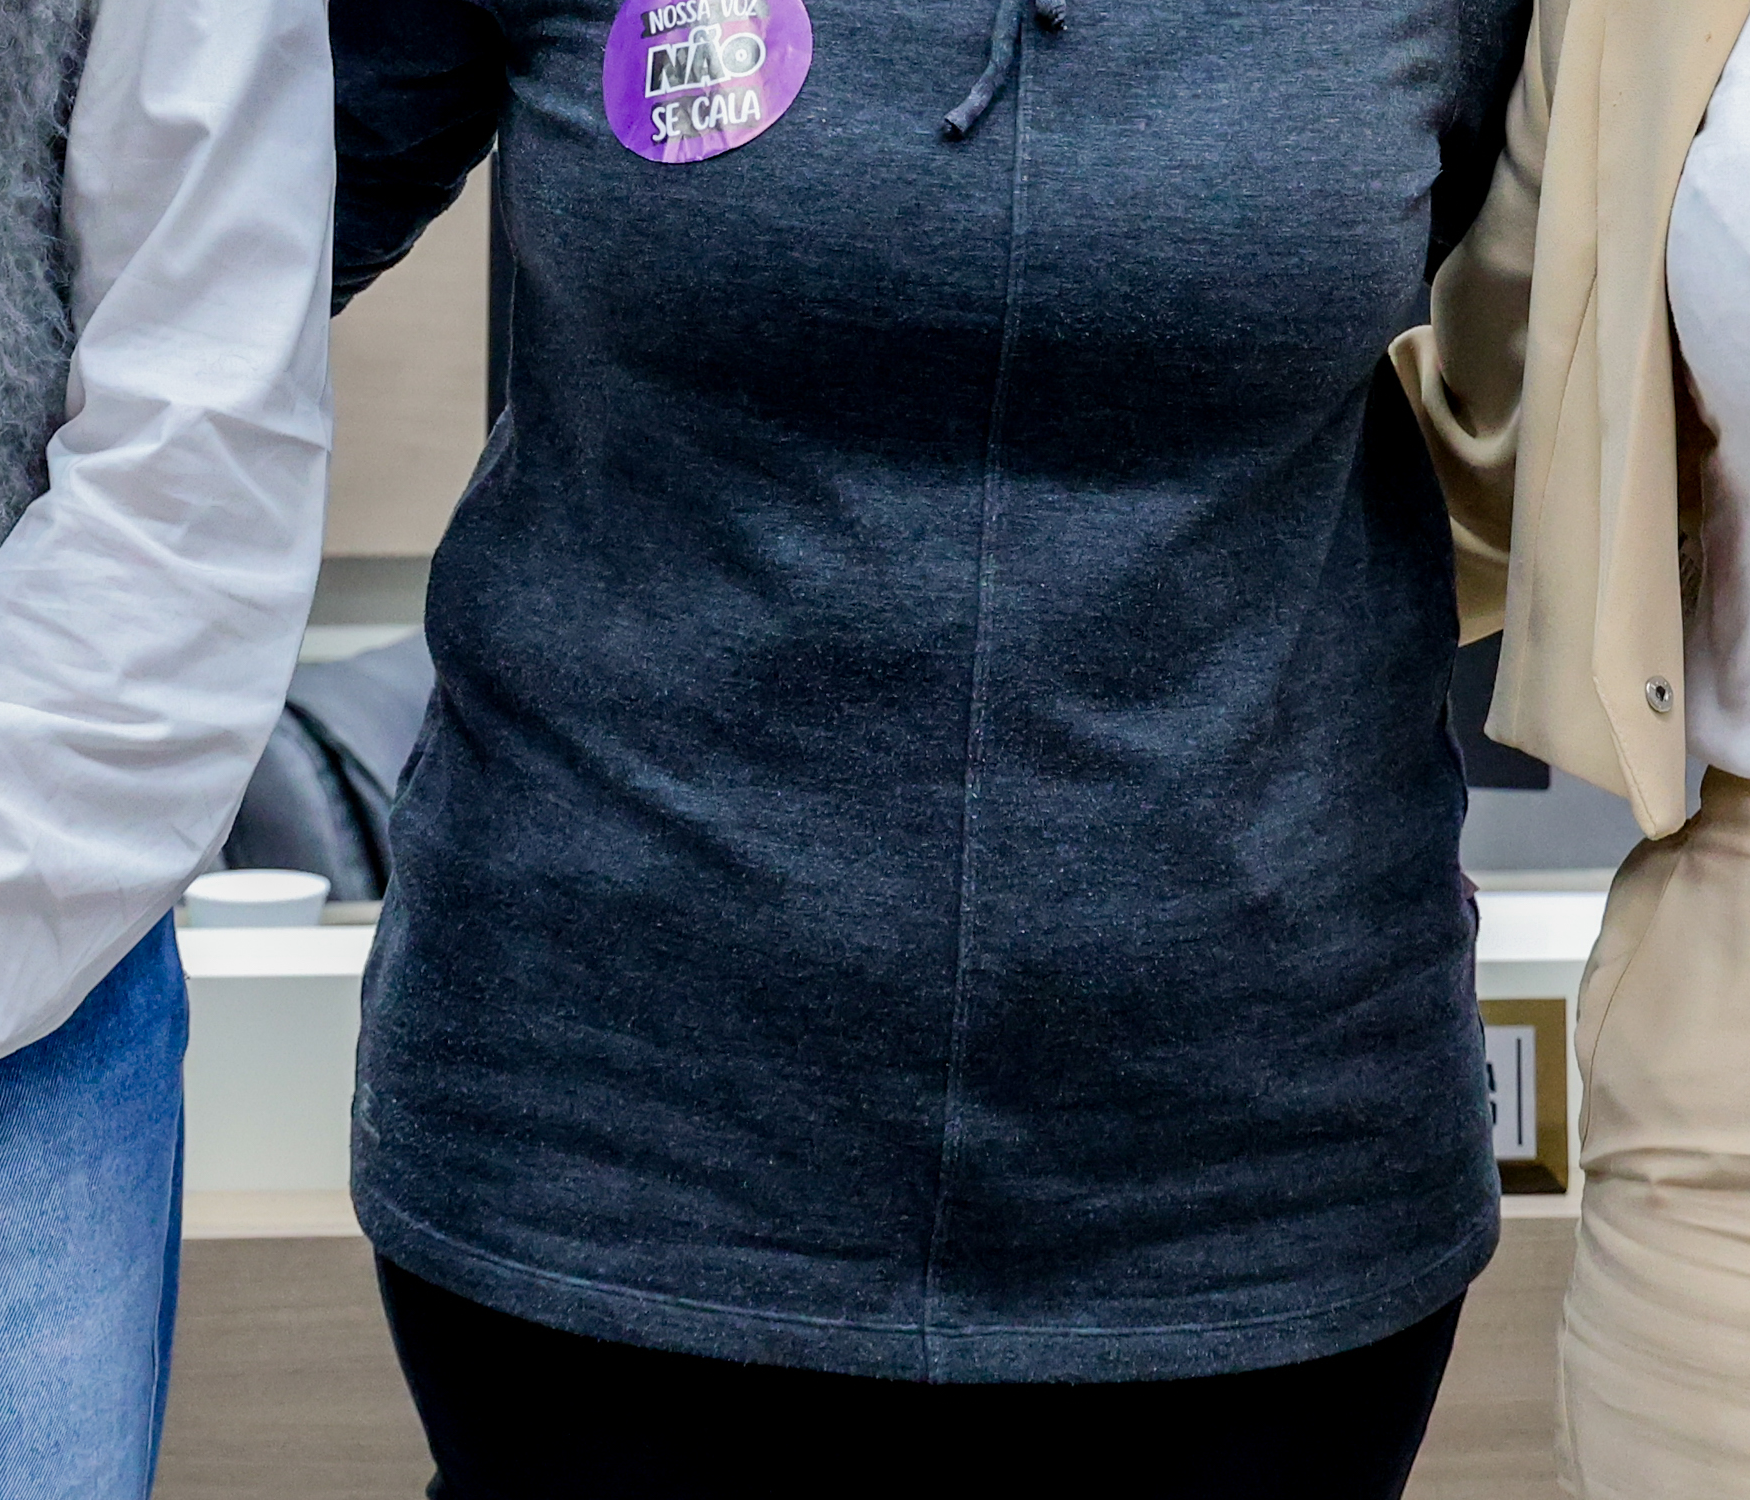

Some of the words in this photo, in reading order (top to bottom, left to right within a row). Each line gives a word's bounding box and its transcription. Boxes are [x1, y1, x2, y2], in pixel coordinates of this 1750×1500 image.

[645, 23, 766, 98] NÃO
[651, 102, 681, 142] SE
[691, 89, 761, 131] CALA
